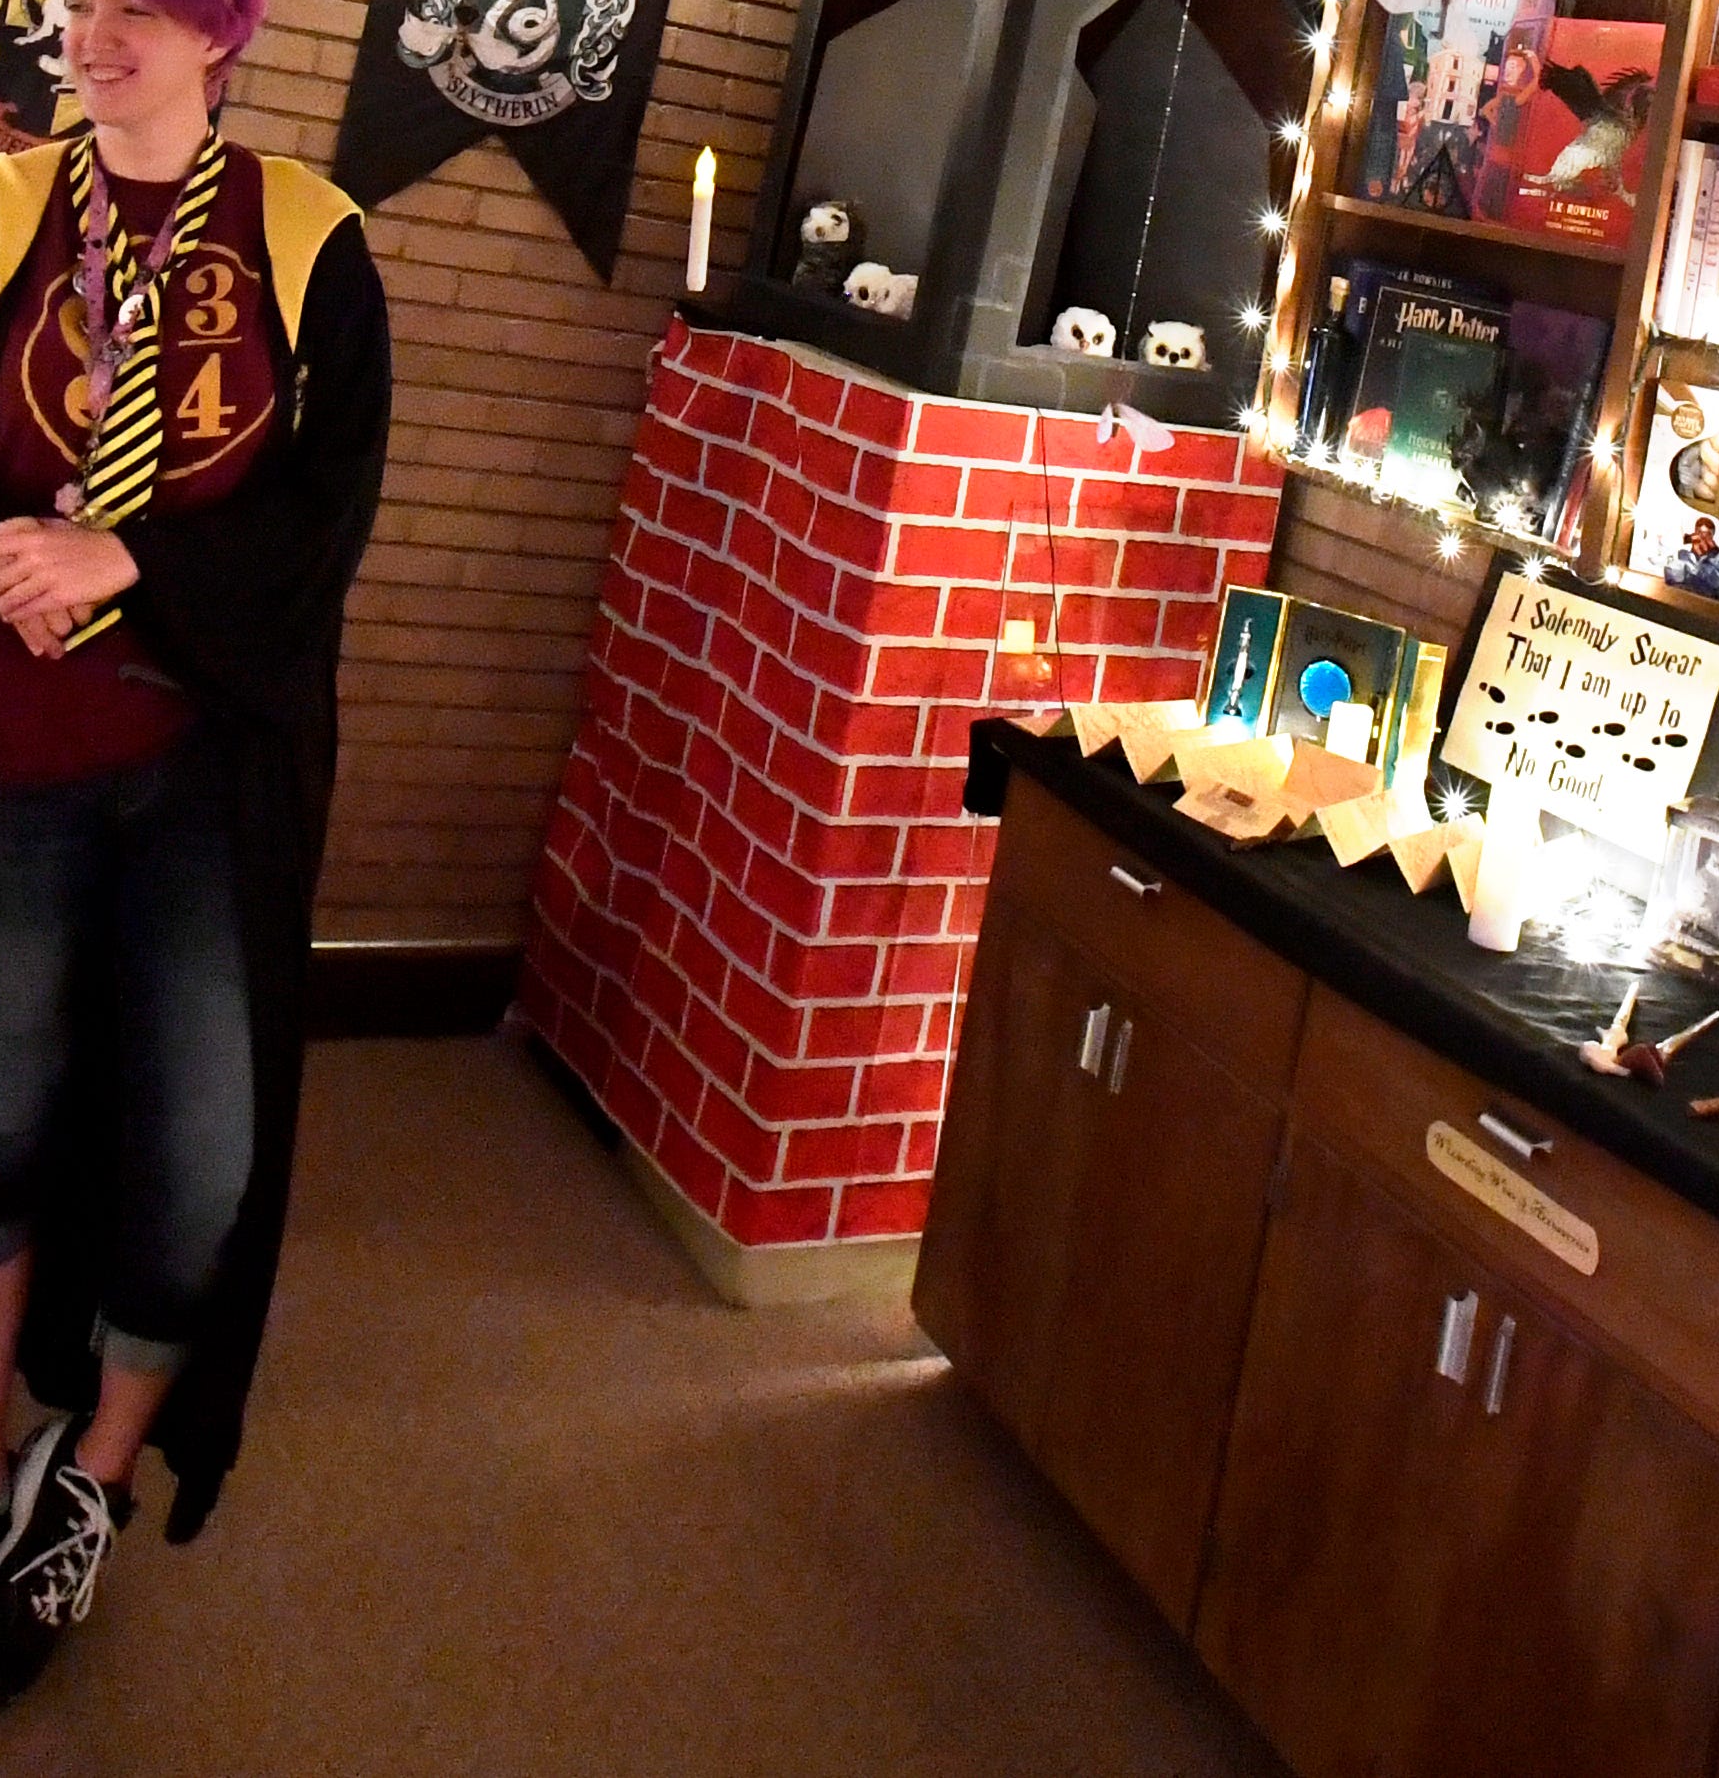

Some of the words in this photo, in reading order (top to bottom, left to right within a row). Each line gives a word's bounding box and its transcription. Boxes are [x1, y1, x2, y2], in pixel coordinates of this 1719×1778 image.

[447, 75, 558, 119] SLYTHERIN
[1566, 203, 1610, 221] ROWLING
[185, 263, 238, 336] 3
[1395, 301, 1446, 334] Harry
[1448, 307, 1500, 343] Potter
[177, 352, 237, 439] 4
[1511, 594, 1524, 622] I
[1530, 598, 1619, 653] Solemnly
[1630, 632, 1702, 677] Swear
[1505, 632, 1552, 680] That
[1560, 660, 1572, 690] I
[1582, 672, 1611, 698] am
[1621, 692, 1647, 721] up
[1659, 698, 1681, 729] to
[1505, 741, 1536, 778] No
